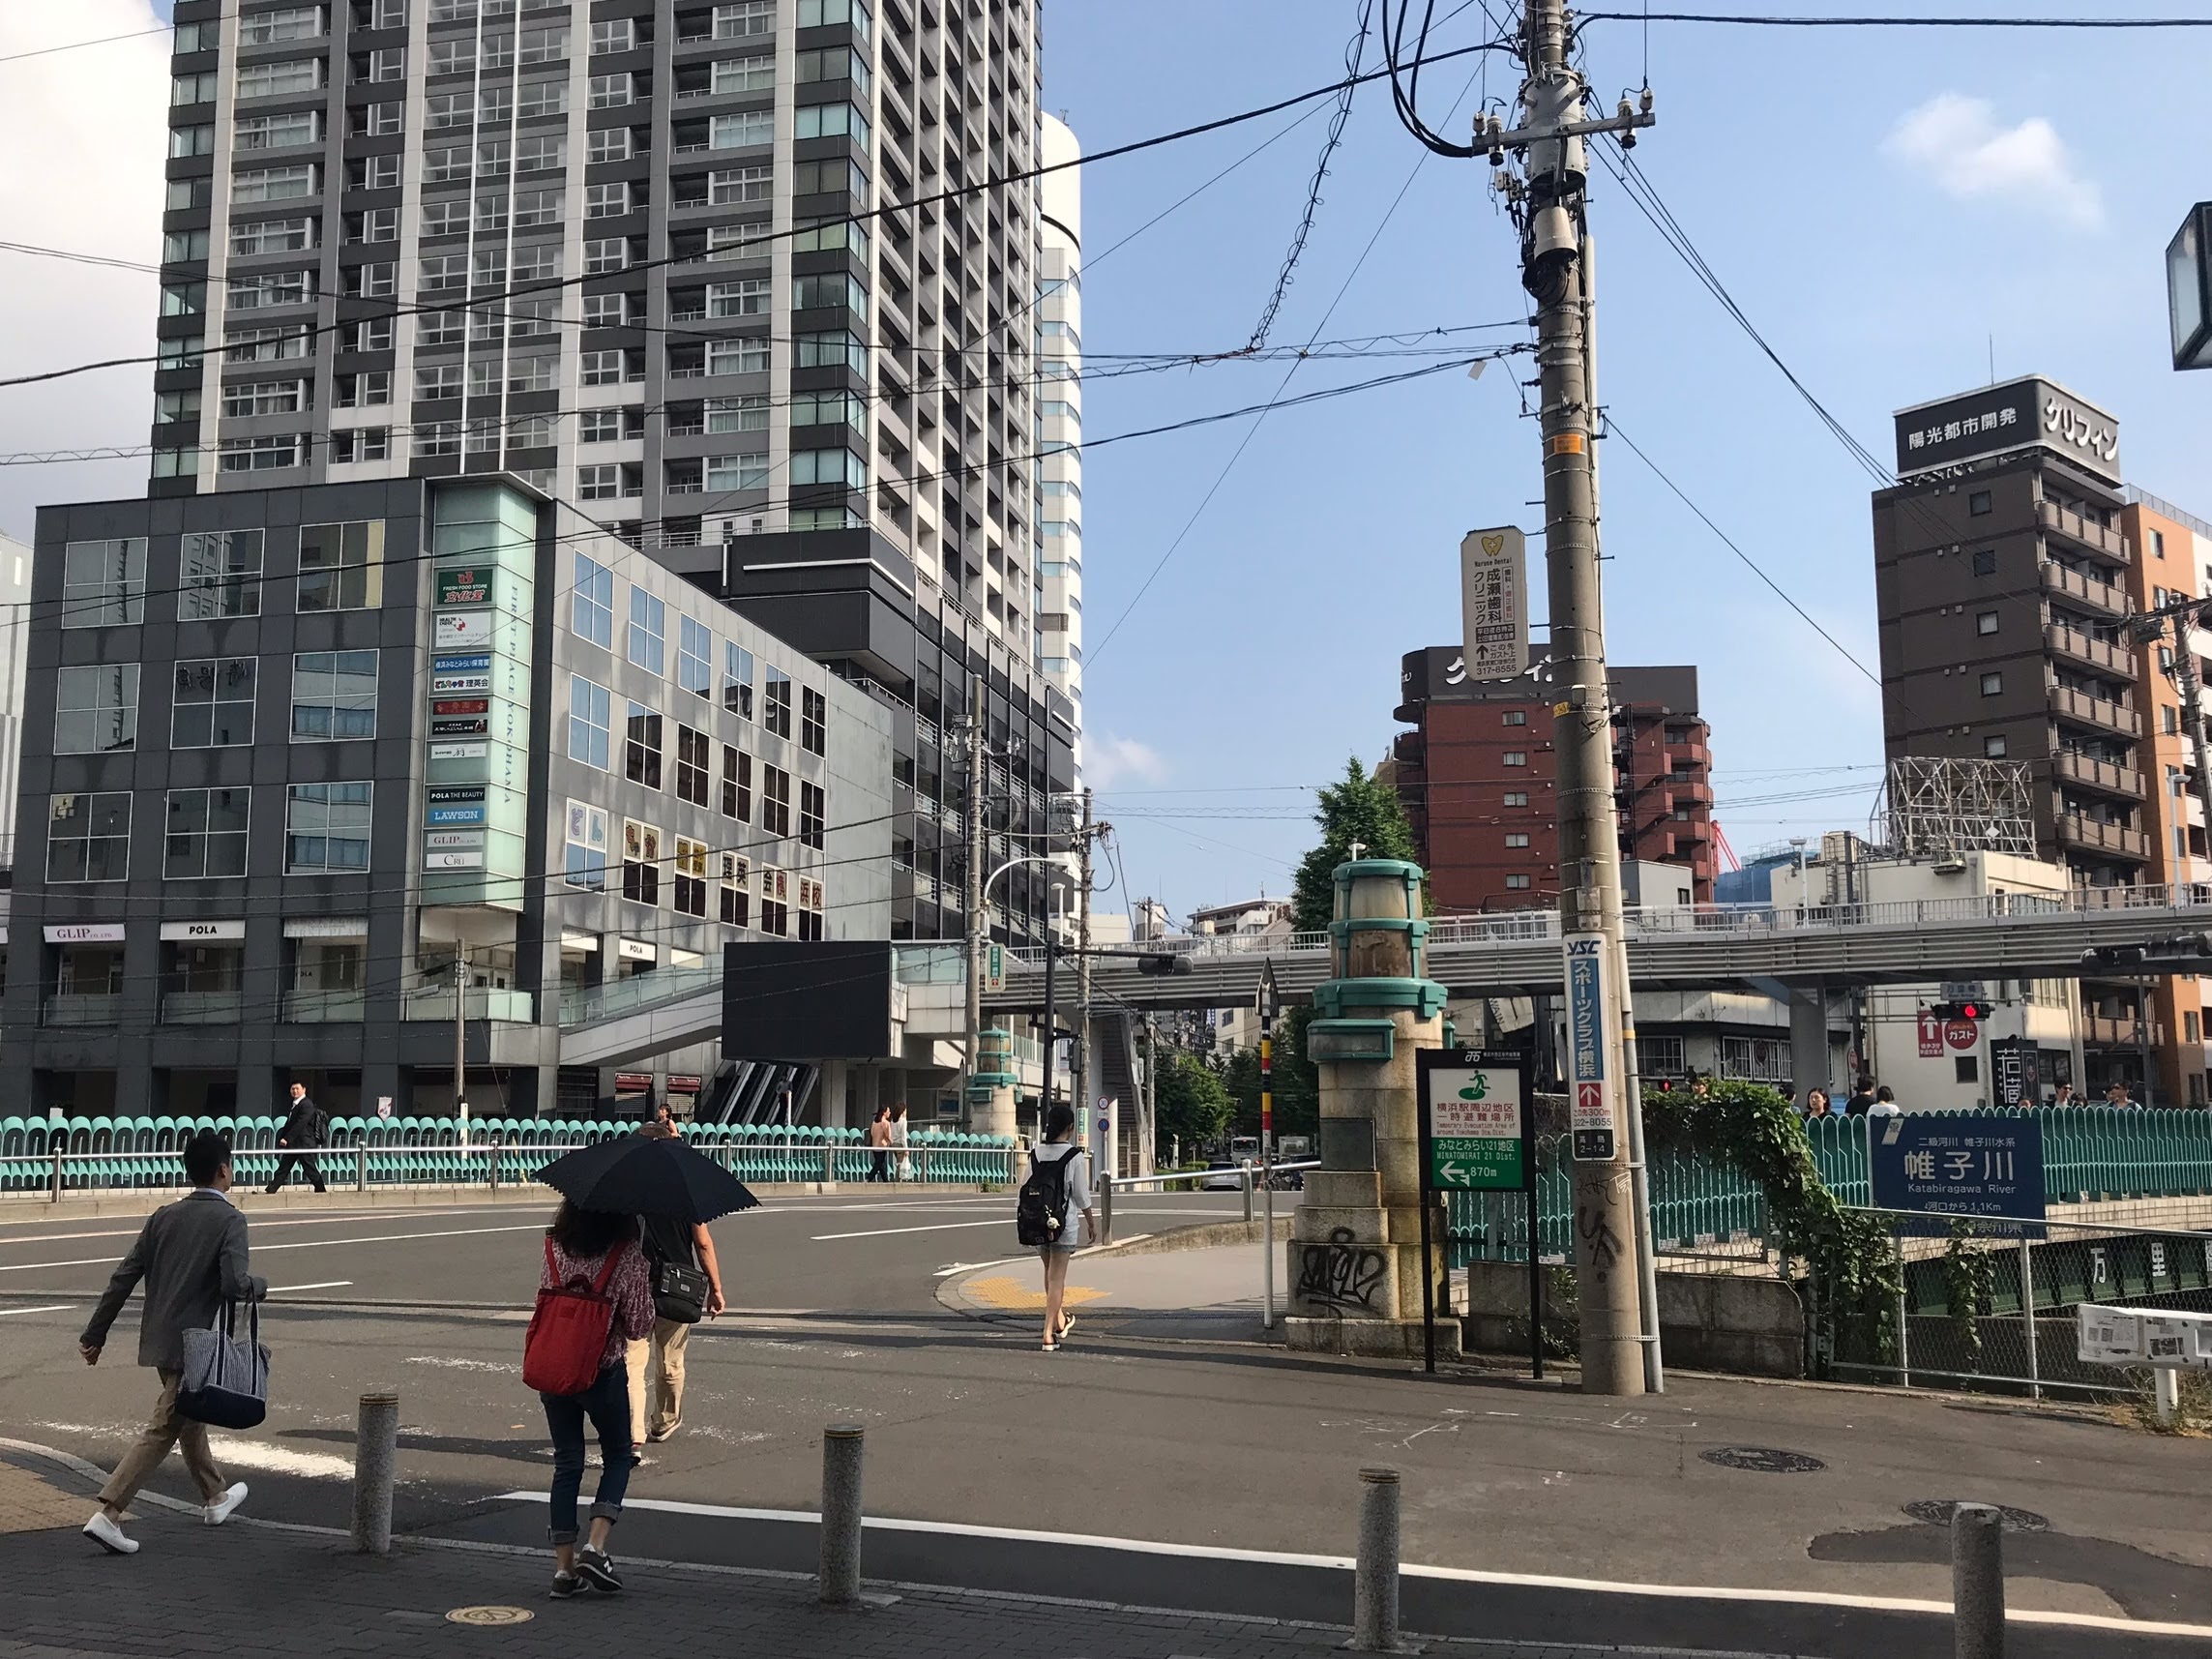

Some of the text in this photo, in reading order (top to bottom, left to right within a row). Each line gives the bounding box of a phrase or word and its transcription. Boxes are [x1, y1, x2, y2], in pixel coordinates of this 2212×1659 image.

[1908, 407, 2017, 450] 陽光都市開発
[2044, 397, 2118, 461] グリフィン
[1474, 571, 1487, 625] クリニック
[1487, 569, 1502, 623] 成瀬歯科
[1490, 643, 1516, 652] この先
[1489, 651, 1516, 660] ガスト上
[1477, 664, 1517, 675] 317-8555
[466, 679, 488, 688] 理英会
[434, 811, 478, 820] LAWSON
[434, 836, 459, 844] GLIP
[57, 929, 90, 938] GLIP
[189, 925, 218, 934] POLA
[630, 944, 642, 954] POLA
[1567, 940, 1601, 956] YSC
[1575, 960, 1596, 1078] スポーツクラブ横浜
[1949, 1030, 1975, 1041] ガスト
[1436, 1103, 1514, 1112] 横浜駅周辺地区
[1437, 1112, 1515, 1122] 一時避難場所
[1438, 1140, 1515, 1152] みなとみらい21地区
[1918, 1138, 2016, 1148] 二級河川 帷子川水系
[1496, 1152, 1516, 1161] Dist.
[1904, 1150, 2014, 1181] 帷子川
[1470, 1167, 1497, 1177] 870m
[1907, 1183, 2017, 1196] Katabiragawa River
